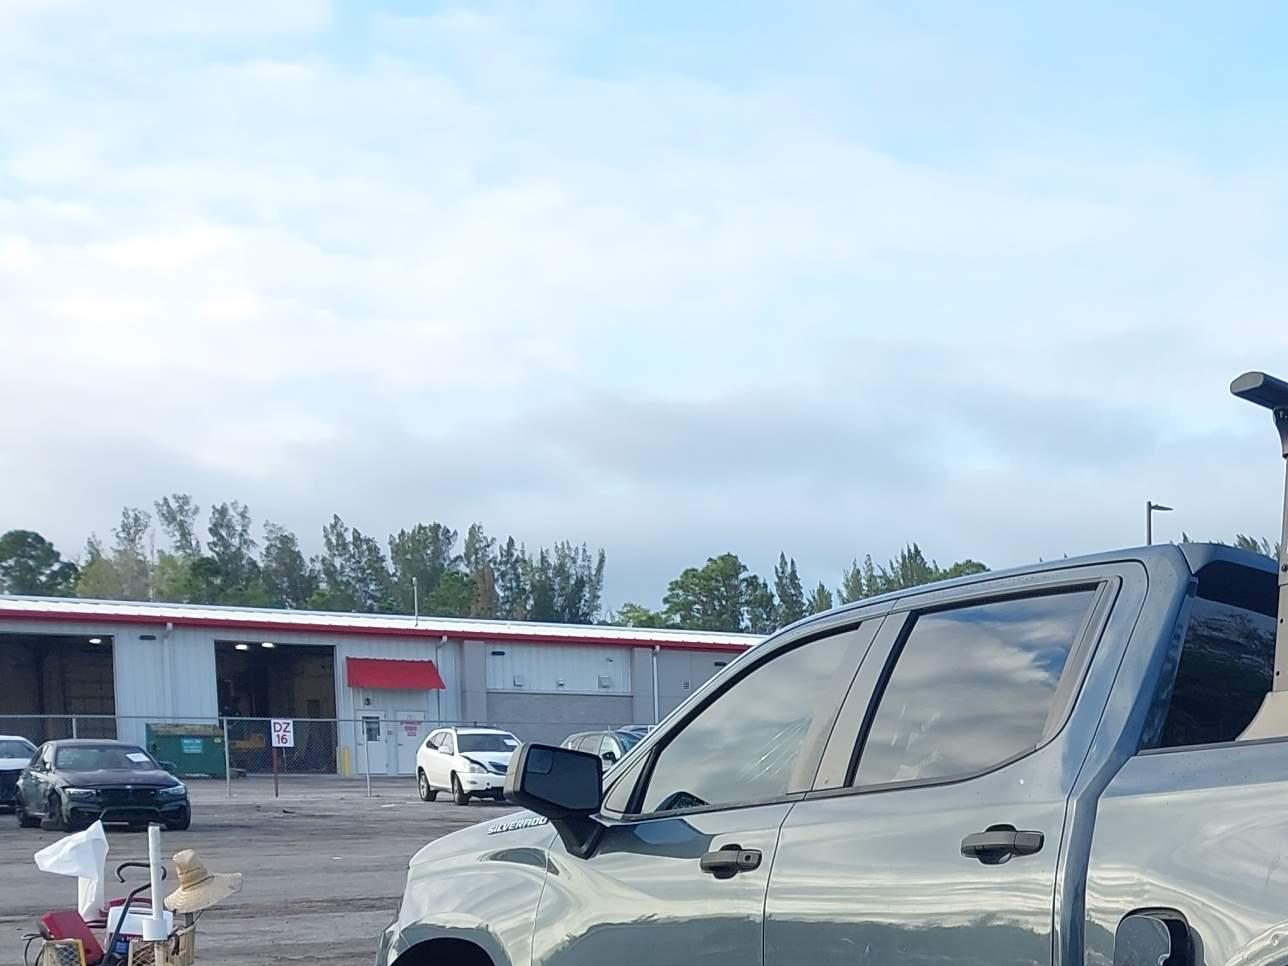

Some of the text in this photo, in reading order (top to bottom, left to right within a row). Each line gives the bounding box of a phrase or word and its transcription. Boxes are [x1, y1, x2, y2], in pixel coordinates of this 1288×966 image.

[272, 721, 292, 734] DZ
[276, 734, 289, 745] 16
[487, 816, 549, 834] SILVERADO
